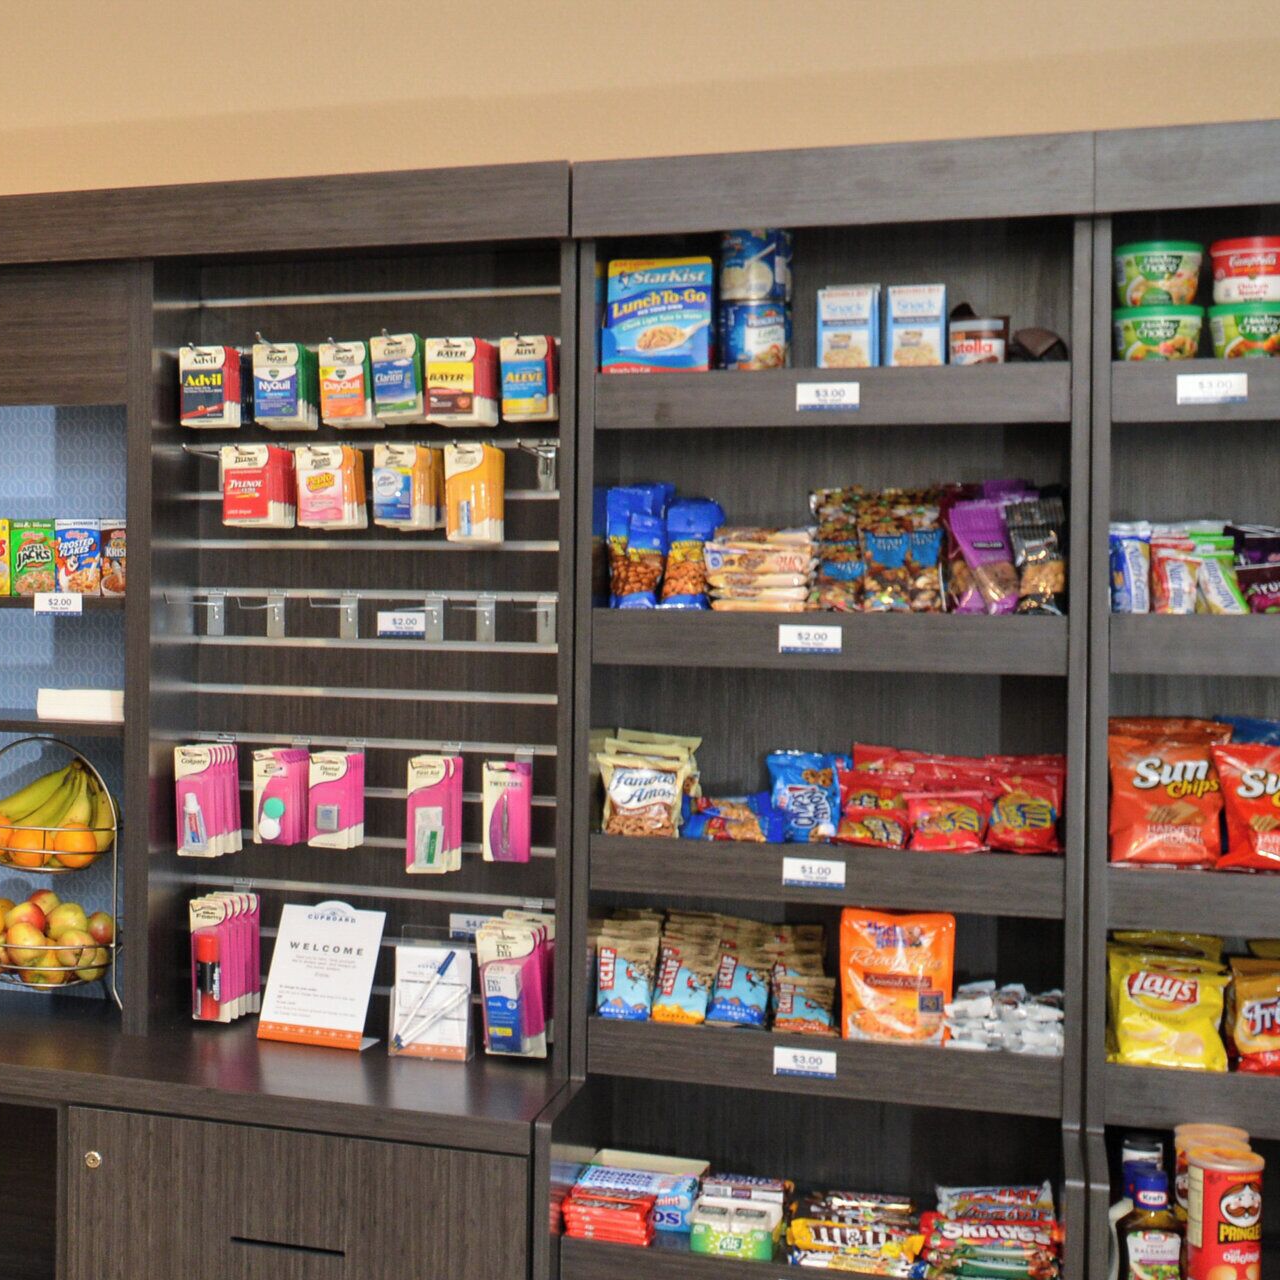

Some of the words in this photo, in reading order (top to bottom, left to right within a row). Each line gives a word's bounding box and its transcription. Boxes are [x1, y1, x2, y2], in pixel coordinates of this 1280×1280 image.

[633, 269, 704, 284] StarKist
[613, 293, 661, 317] Lunch
[661, 288, 706, 304] To-Go
[193, 356, 217, 365] Advil
[186, 374, 222, 386] Advil
[376, 373, 403, 383] Claritin
[505, 373, 543, 383] ALEVE
[259, 382, 290, 391] NyQuil
[324, 381, 360, 392] DayQuil
[815, 389, 845, 398] $3.00
[60, 538, 93, 550] FROSTED
[60, 546, 90, 558] FLAKES
[16, 550, 51, 571] JACKS
[392, 617, 417, 626] $2.00
[797, 632, 828, 641] $2.00
[1133, 757, 1209, 790] Sun
[614, 771, 677, 790] Famous
[1167, 779, 1218, 798] Chips
[627, 785, 675, 804] Amos
[800, 866, 832, 875] $1.00
[308, 914, 356, 923] CUPBOARD
[465, 920, 484, 928] $4.0
[291, 941, 363, 956] WELCOME
[792, 1055, 822, 1065] $3.00
[1141, 1193, 1164, 1202] Kraft
[942, 1223, 1050, 1245] Skittles
[1220, 1224, 1261, 1242] PRINGLE
